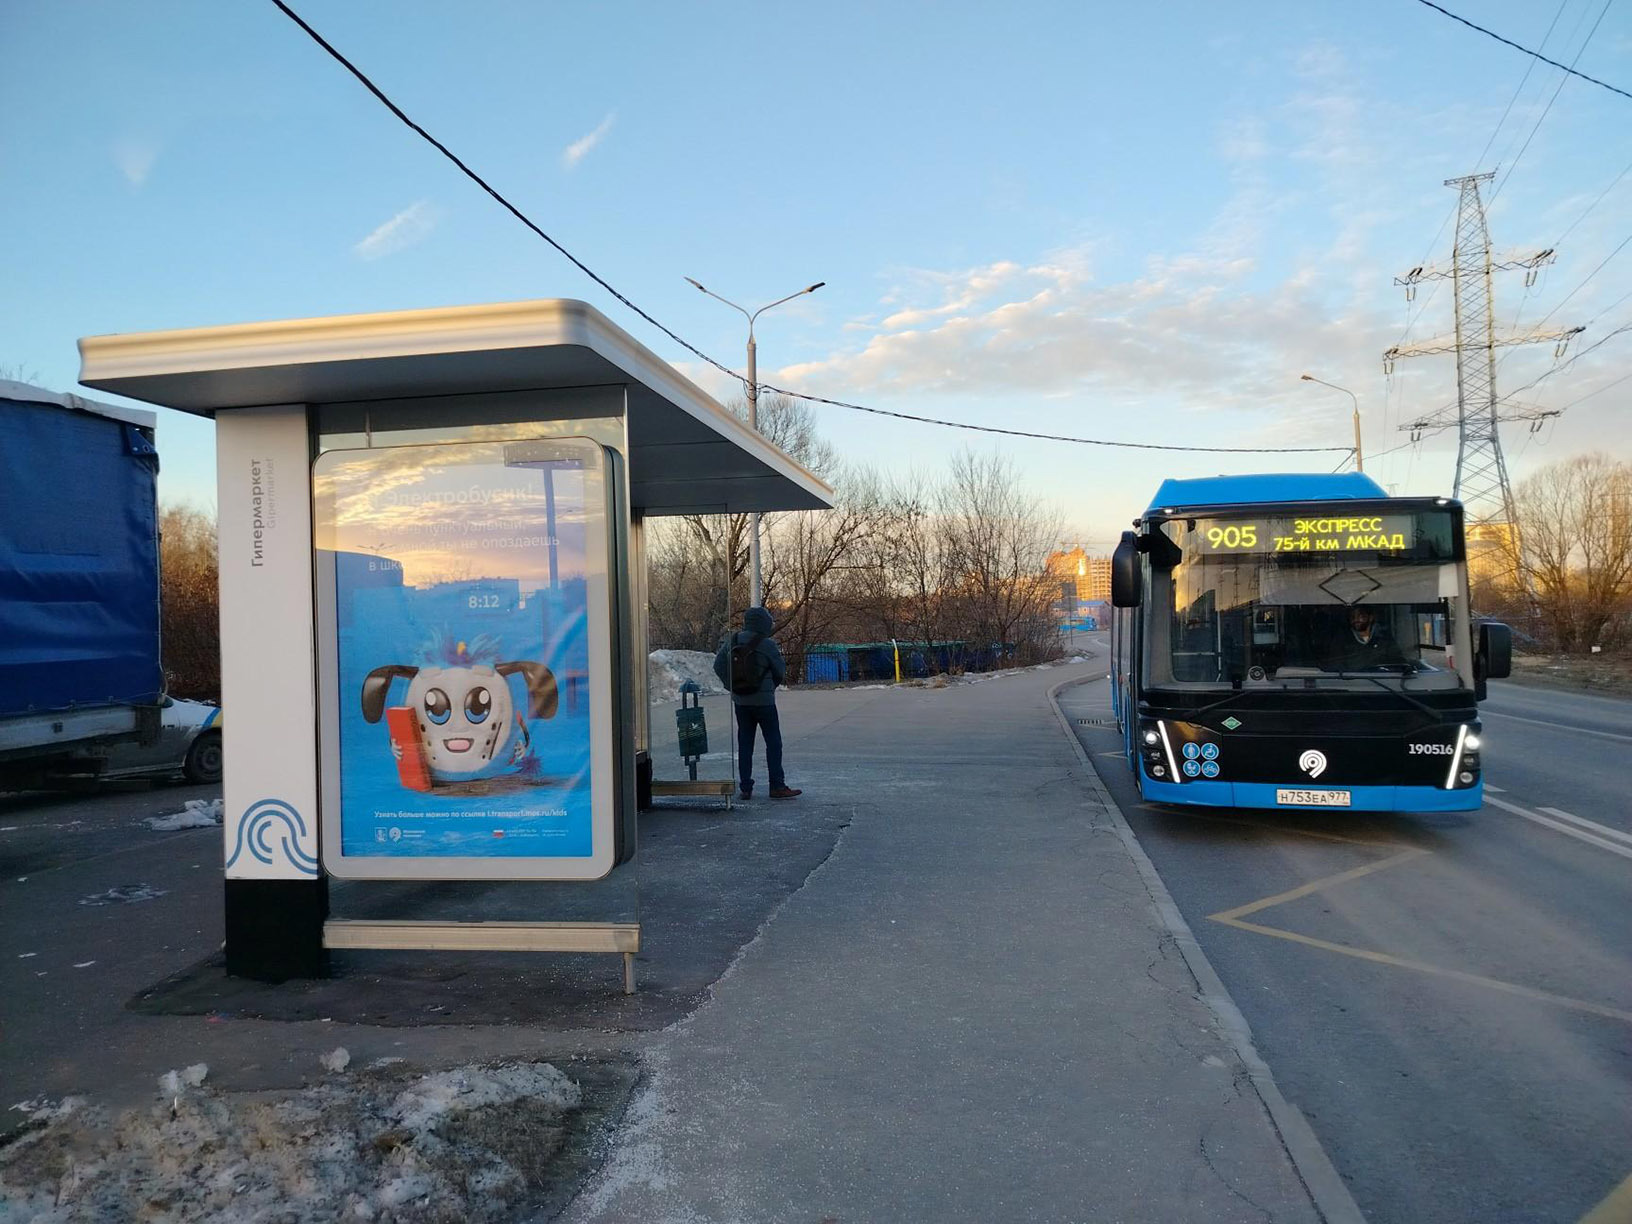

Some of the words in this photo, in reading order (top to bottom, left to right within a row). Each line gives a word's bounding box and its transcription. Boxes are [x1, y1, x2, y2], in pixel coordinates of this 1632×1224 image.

[251, 458, 265, 567] Гипермаркет
[1294, 517, 1383, 534] ЭКСПРЕСС
[461, 540, 478, 549] не
[482, 536, 560, 550] опоздаешь
[1207, 526, 1257, 549] 905
[1273, 537, 1310, 551] 75-й
[1316, 539, 1340, 550] км
[1346, 534, 1406, 550] МКАД
[368, 562, 377, 571] в
[468, 595, 500, 609] 8:12
[1408, 743, 1454, 755] 190516
[374, 810, 397, 818] Узнать
[398, 810, 425, 818] больше
